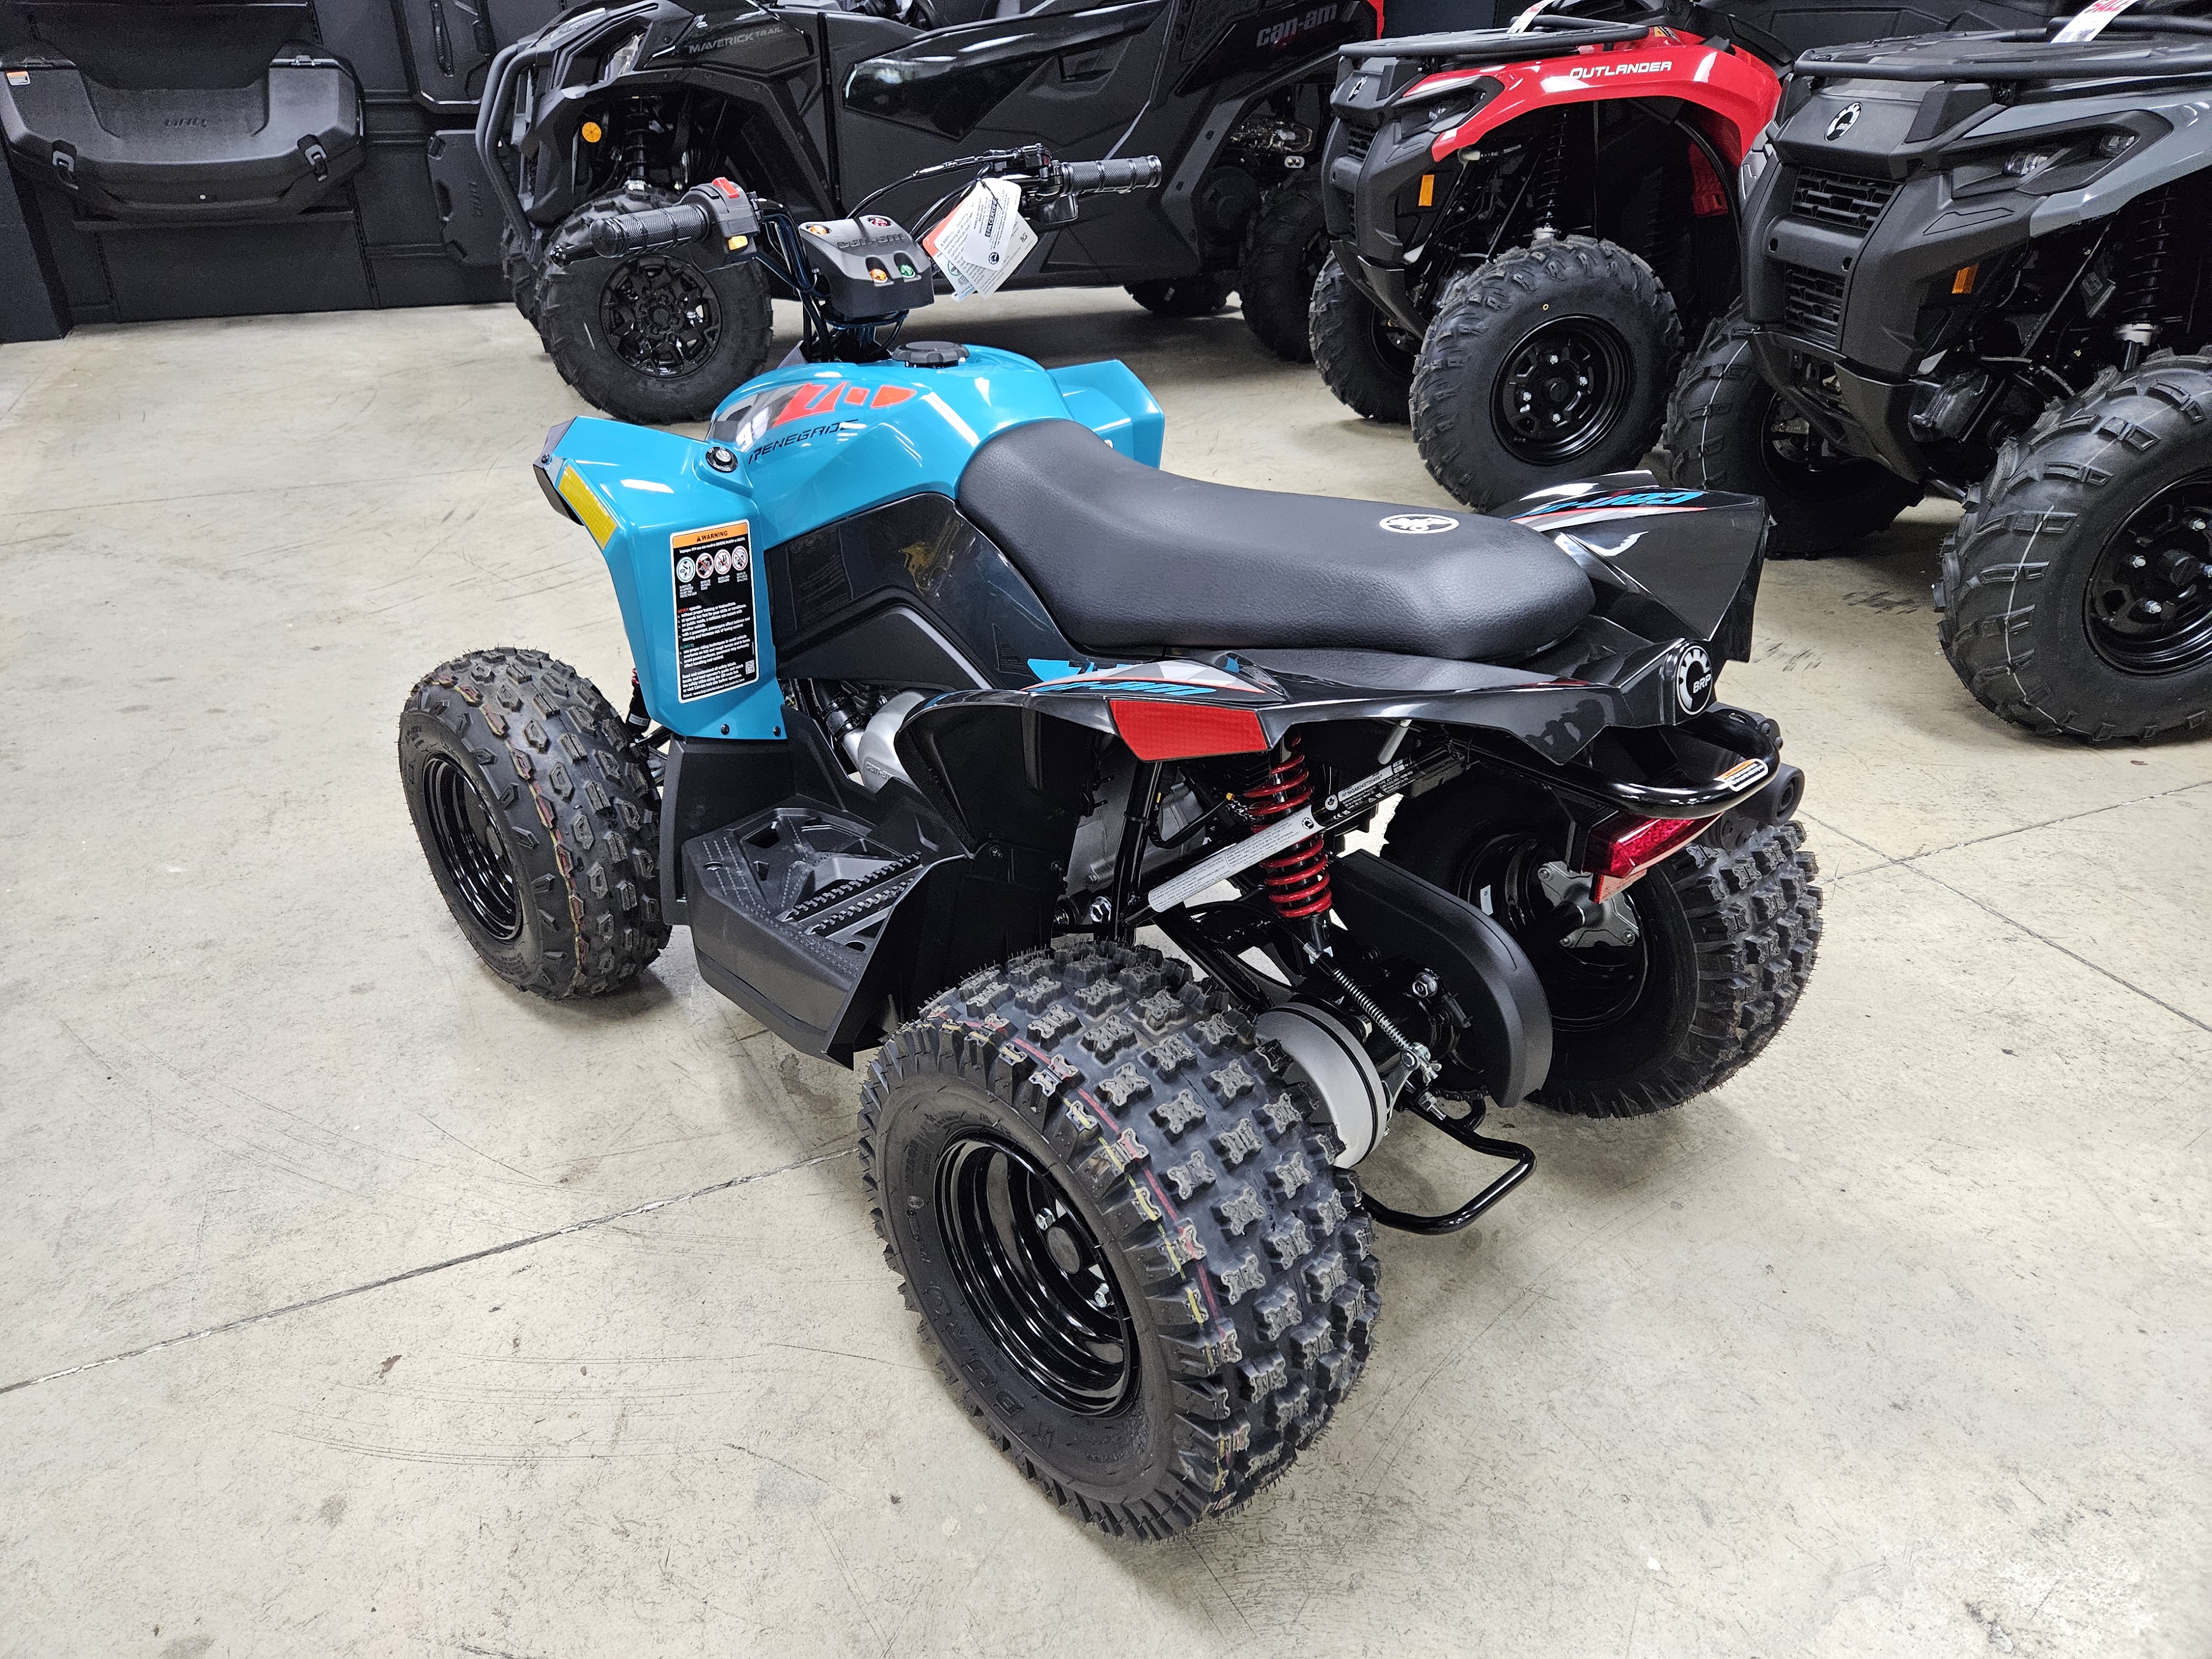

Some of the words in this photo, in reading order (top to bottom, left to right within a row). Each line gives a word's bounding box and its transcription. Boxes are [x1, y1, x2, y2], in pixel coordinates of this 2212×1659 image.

[1256, 3, 1338, 48] can-am
[689, 33, 754, 54] MAVERICK
[1569, 61, 1672, 79] OUTLANDER
[837, 233, 906, 249] can-am
[702, 531, 727, 540] WARNING
[1693, 674, 1712, 693] BRP
